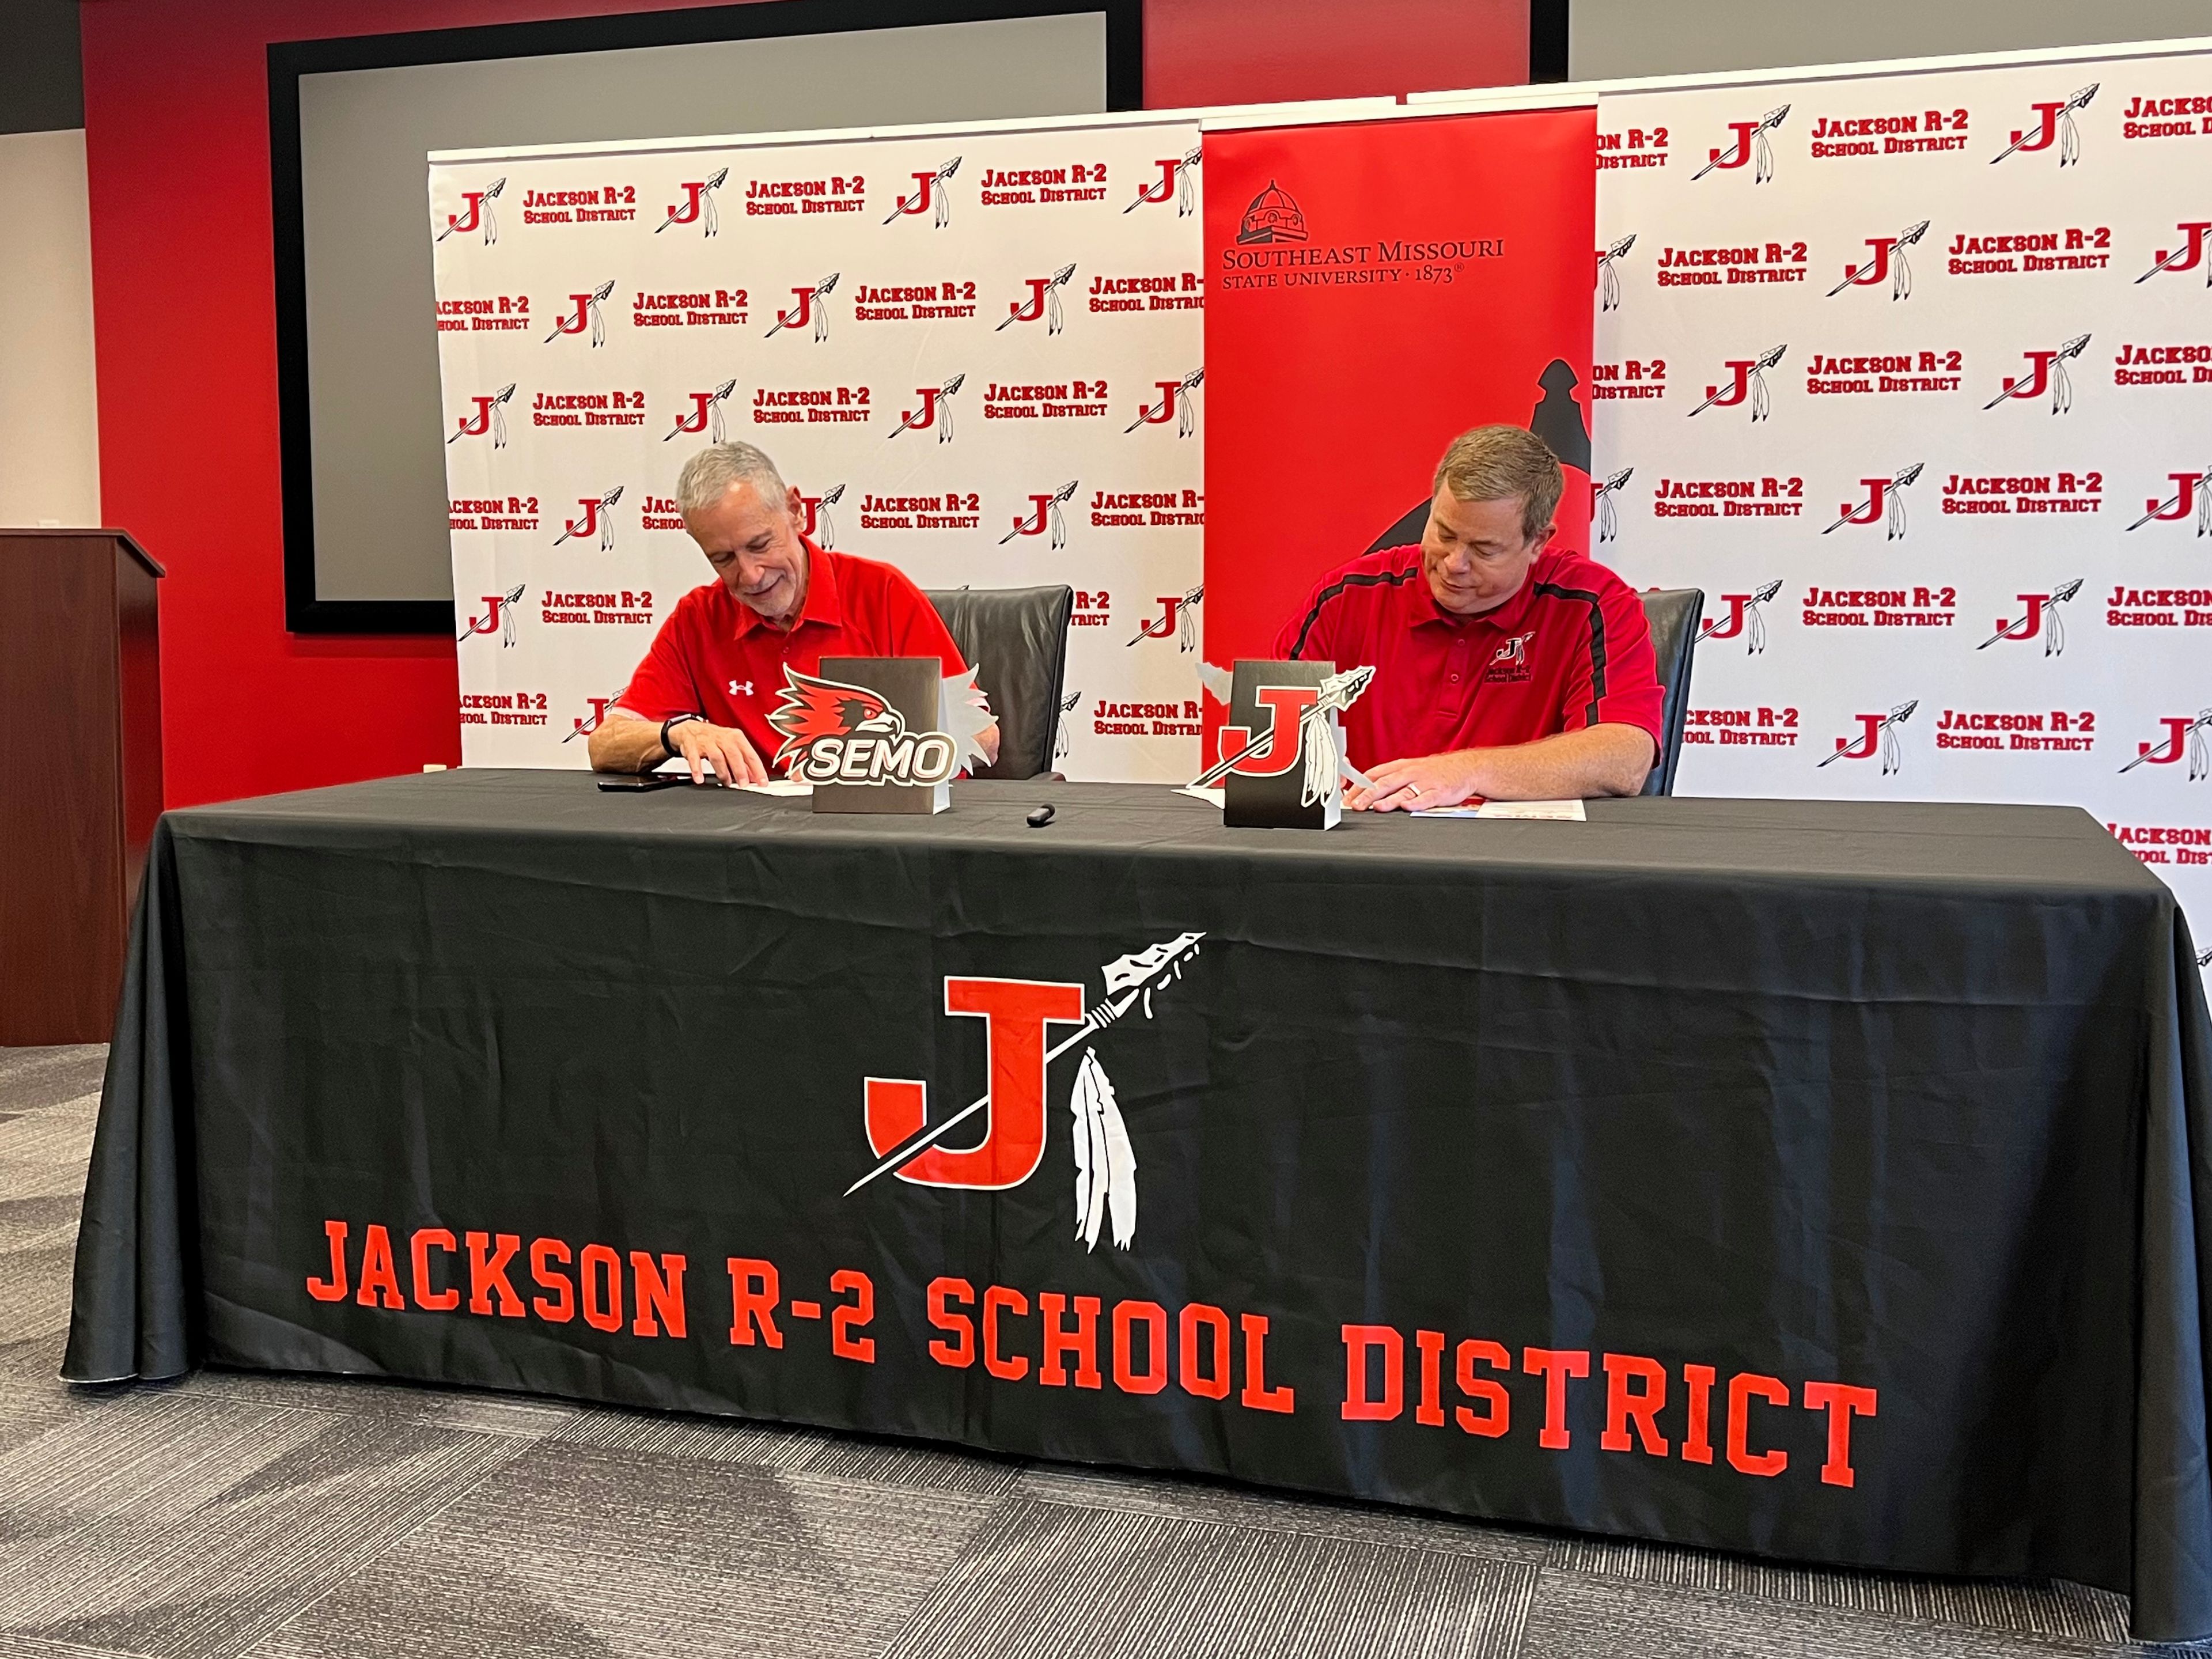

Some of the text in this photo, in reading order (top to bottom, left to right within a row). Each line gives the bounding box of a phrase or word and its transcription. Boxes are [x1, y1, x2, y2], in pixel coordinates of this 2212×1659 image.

[1812, 109, 1968, 138] JACKSON R-2
[2011, 104, 2065, 151] J
[2124, 122, 2196, 138] SCHOOL
[1628, 128, 1668, 149] R-2
[1710, 122, 1759, 168] J
[1812, 136, 1967, 157] SCHOOL DISTRICT
[982, 164, 1106, 187] JACKSON R-2
[1139, 160, 1181, 203] J
[524, 186, 635, 207] JACKSON R-2
[746, 176, 864, 198] JACKSON R-2
[897, 172, 936, 214] J
[982, 188, 1106, 205] SCHOOL DISTRICT
[449, 192, 484, 232] J
[668, 183, 704, 224] J
[747, 199, 864, 215] SCHOOL DISTRICT
[524, 209, 635, 224] SCHOOL DISTRICT
[1949, 228, 2110, 255] JACKSON R-2
[2156, 222, 2211, 271] J
[1222, 240, 1503, 270] SOUTHEAST MISSOURI
[1658, 243, 1806, 267] JACKSON R-2
[1846, 238, 1897, 285] J
[1949, 255, 2109, 274] SCHOOL DISTRICT
[1089, 276, 1176, 294] JACKSON
[1222, 274, 1277, 289] STATE
[1284, 268, 1402, 286] UNIVERSITY
[1658, 268, 1806, 286] SCHOOL DISTRICT
[633, 290, 747, 309] JACKSON R-2
[855, 282, 975, 303] JACKSON R-2
[1010, 279, 1050, 321] J
[436, 296, 529, 315] ACKSON R-2
[556, 294, 592, 334] J
[778, 288, 816, 328] J
[856, 305, 975, 320] SCHOOL DISTRICT
[1089, 298, 1145, 312] SCHOOL
[436, 317, 529, 331] HOOL DISTRICT
[634, 312, 747, 326] SCHOOL DISTRICT
[1808, 351, 1961, 374] JACKSON R-2
[2116, 345, 2212, 365] JACKSO
[1626, 360, 1665, 380] R-2
[2003, 351, 2058, 398] J
[2115, 369, 2186, 385] SCHOOL
[984, 381, 1107, 401] JACKSON R-2
[1706, 361, 1755, 406] J
[1808, 376, 1961, 394] SCHOOL DISTRICT
[533, 392, 644, 410] JACKSON R-2
[753, 387, 870, 406] JACKSON R-2
[1139, 381, 1182, 423] J
[459, 397, 494, 435] J
[676, 393, 714, 433] J
[754, 408, 870, 423] SCHOOL DISTRICT
[902, 388, 941, 429] J
[984, 403, 1107, 418] SCHOOL DISTRICT
[533, 412, 645, 426] SCHOOL DISTRICT
[1655, 478, 1802, 498] JACKSON R-2
[1943, 472, 2102, 494] JACKSON R-2
[449, 497, 538, 513] CKSON R-2
[861, 494, 979, 512] JACKSON R-2
[1091, 491, 1176, 509] JACKSON
[1841, 479, 1892, 524] J
[1942, 497, 2101, 514] SCHOOL DISTRICT
[2147, 474, 2203, 520] J
[566, 499, 601, 537] J
[1014, 495, 1053, 535] J
[1092, 512, 1146, 526] SCHOOL
[1655, 501, 1802, 517] SCHOOL DISTRICT
[481, 517, 538, 529] DISTRICT
[642, 516, 686, 529] SCHOO
[861, 514, 979, 528] SCHOOL DISTRICT
[542, 591, 652, 608] JACKSON R-2
[1076, 592, 1109, 609] R-2
[1803, 588, 1955, 607] JACKSON R-2
[469, 597, 503, 634] J
[543, 610, 653, 624] SCHOOL DISTRICT
[1141, 598, 1183, 638] J
[1803, 610, 1955, 626] SCHOOL DISTRICT
[1997, 594, 2050, 639] J
[2107, 610, 2178, 626] SCHOOL
[460, 693, 547, 709] CKSON R-2
[1094, 700, 1178, 718] JACKSON
[491, 711, 547, 725] DISTRICT
[1094, 721, 1147, 734] SCHOOL
[1685, 708, 1798, 727] CKSON R-2
[1937, 710, 2094, 731] JACKSON R-2
[1218, 687, 1317, 775] J
[1720, 729, 1797, 745] DISTRICT
[1836, 715, 1886, 758] J
[2139, 718, 2194, 763] J
[1937, 733, 2093, 750] SCHOOL DISTRICT
[808, 739, 949, 778] SEMO
[864, 976, 1084, 1190] J
[307, 1221, 1876, 1487] JACKSON R-2 SCHOOL DISTRICT
